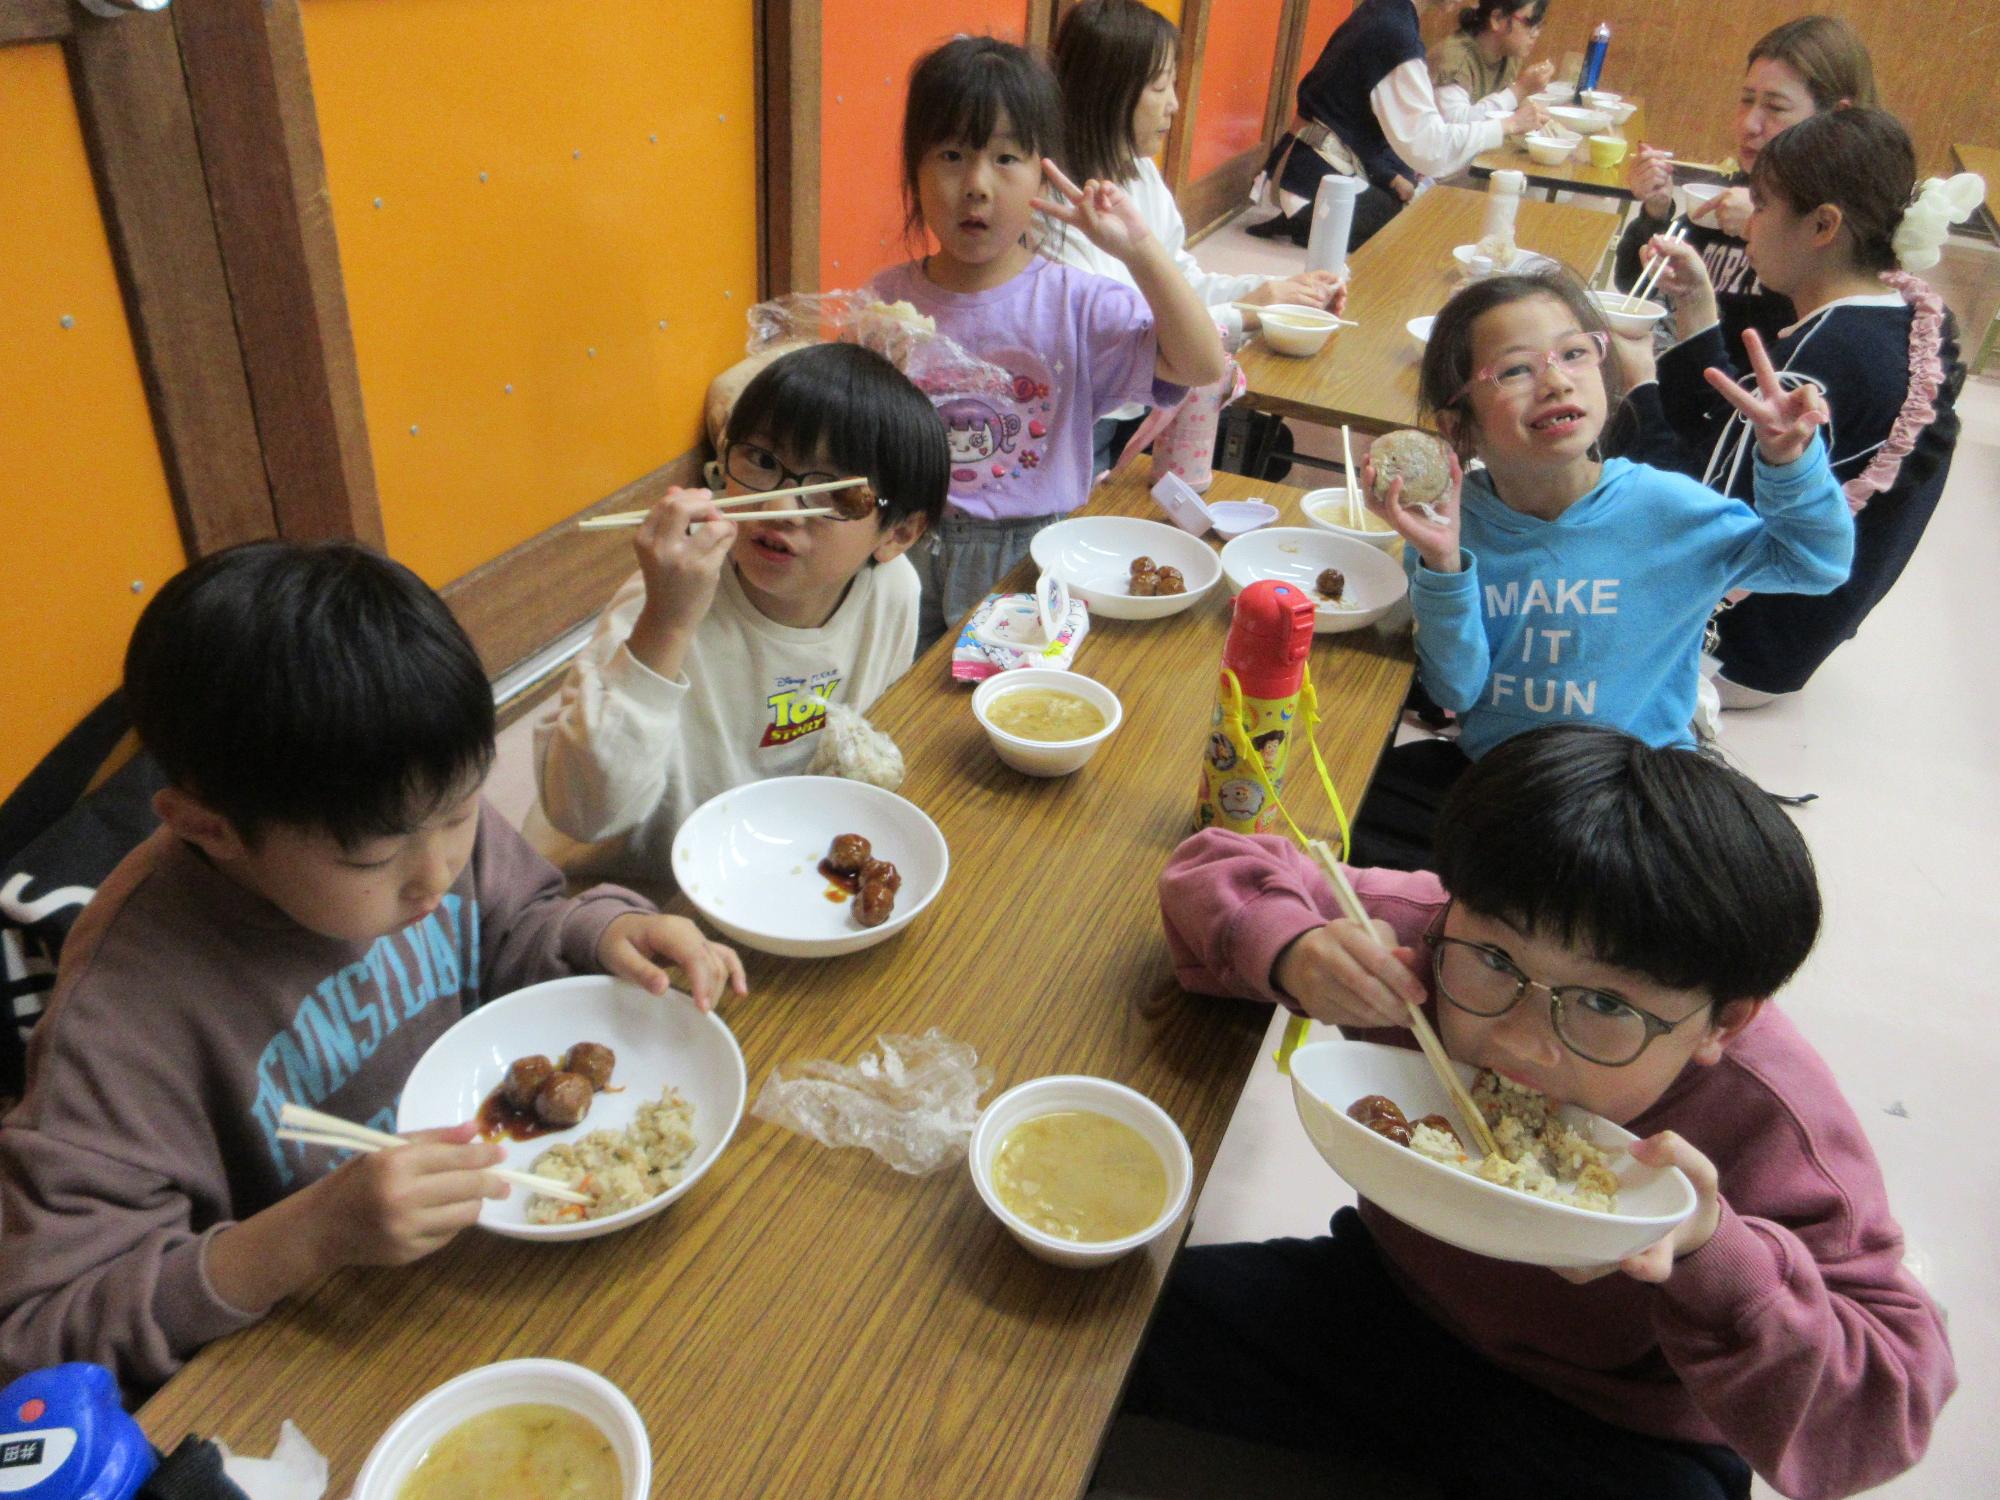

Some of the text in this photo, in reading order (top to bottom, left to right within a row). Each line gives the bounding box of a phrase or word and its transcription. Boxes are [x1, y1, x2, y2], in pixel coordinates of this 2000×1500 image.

[1485, 578, 1621, 618] MAKE
[1521, 626, 1571, 664] IT
[767, 678, 841, 728] TOY
[1491, 672, 1597, 716] FUN
[771, 717, 827, 740] STORY
